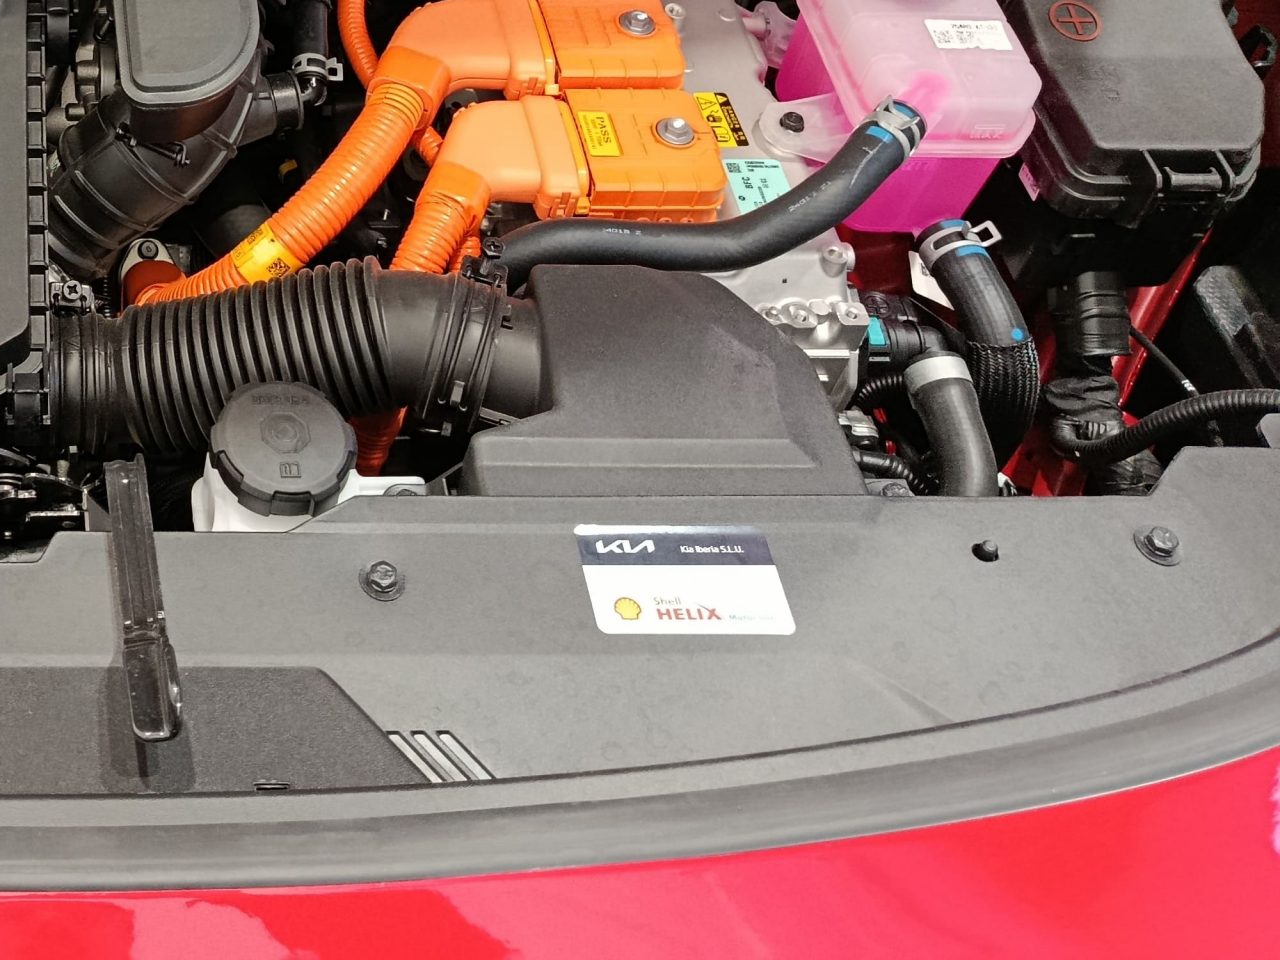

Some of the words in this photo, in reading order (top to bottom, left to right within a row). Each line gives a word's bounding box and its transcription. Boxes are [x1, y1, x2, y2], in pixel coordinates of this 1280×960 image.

[595, 116, 612, 144] PASS
[741, 176, 754, 189] BFC
[680, 545, 694, 553] Kia
[695, 545, 720, 553] Iberia
[654, 597, 681, 606] Shell
[656, 607, 722, 621] HELIX
